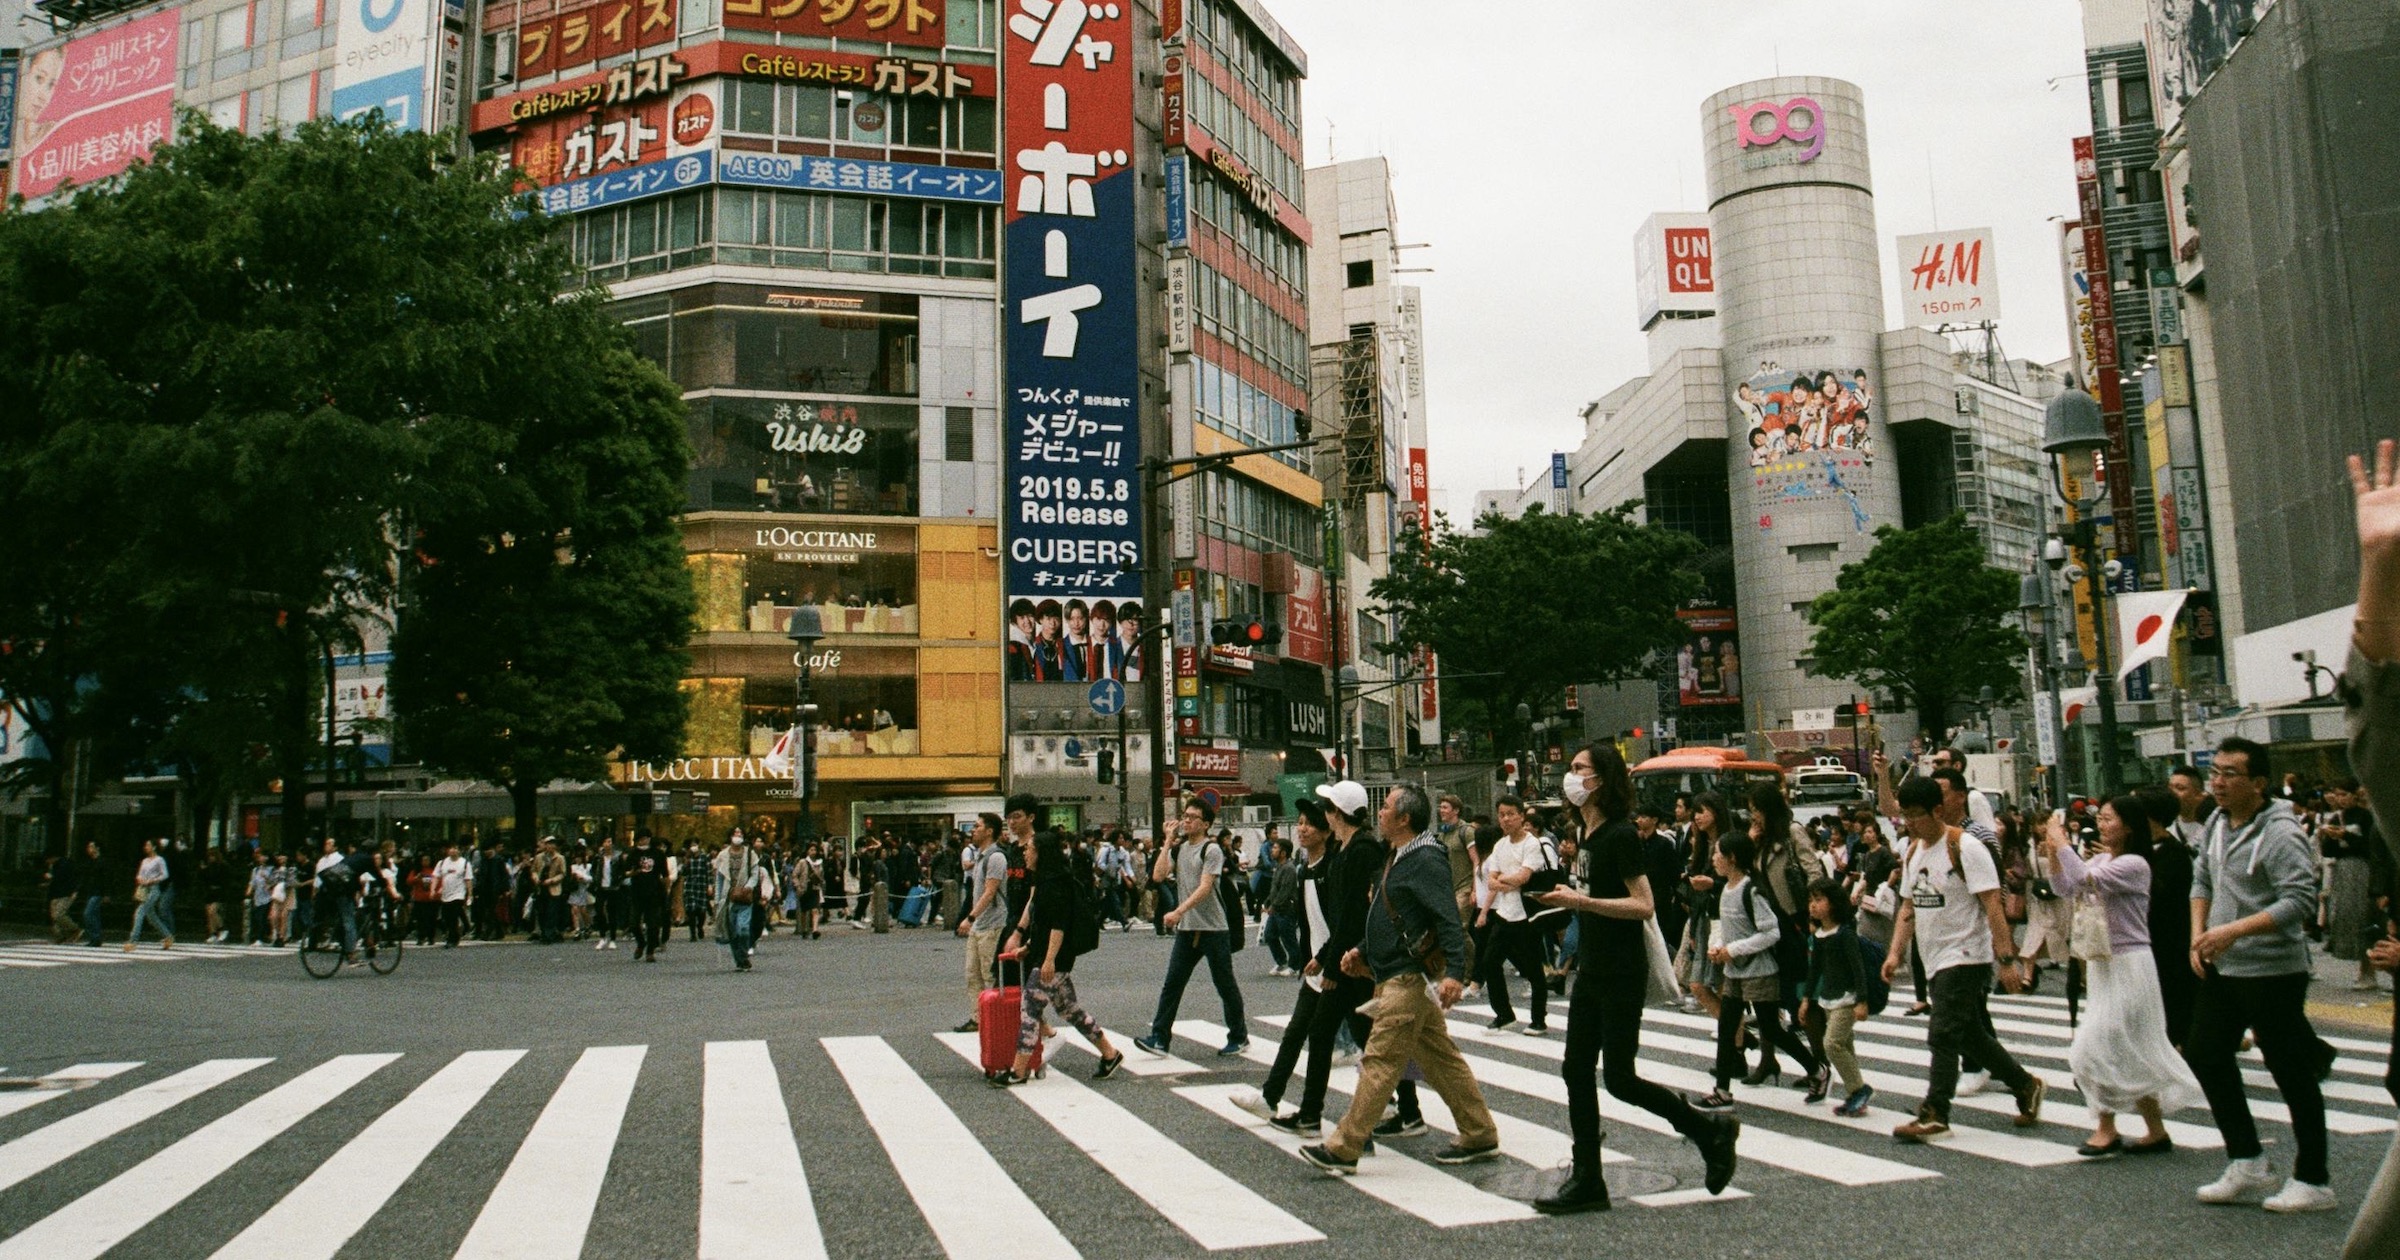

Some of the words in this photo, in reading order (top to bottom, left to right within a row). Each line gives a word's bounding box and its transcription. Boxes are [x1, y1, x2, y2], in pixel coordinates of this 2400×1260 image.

[522, 0, 673, 66] プライス
[91, 27, 174, 70] 品川スキン
[346, 33, 413, 70] eyecity
[90, 56, 161, 97] クリニック
[606, 54, 685, 105] ガスト
[873, 59, 972, 98] ガスト
[677, 116, 710, 134] ガスト
[1168, 95, 1181, 137] ガスト
[1728, 97, 1825, 162] 109
[40, 118, 164, 180] 品川美容外科
[564, 117, 658, 179] ガスト
[728, 157, 793, 179] AEON
[809, 160, 996, 196] 英会話イーオン
[1672, 236, 1710, 258] UN
[1675, 262, 1710, 289] QL
[1911, 239, 1982, 291] H&M
[1172, 267, 1185, 345] 渋谷駅前ビル
[1024, 409, 1123, 438] メジャー
[1020, 476, 1129, 501] 2019.5.8
[1412, 462, 1425, 488] 免税
[1022, 501, 1128, 525] Release
[1325, 502, 1334, 529] レイク
[756, 527, 877, 549] L'OCCITANE
[1012, 538, 1137, 564] CUBERS
[777, 553, 791, 561] EN
[797, 553, 856, 562] PROVENCE
[1032, 570, 1124, 587] キューバーズ
[2123, 568, 2134, 592] MIZ
[1294, 602, 1317, 632] アコム
[793, 650, 841, 673] Café
[1290, 702, 1325, 735] LUSH
